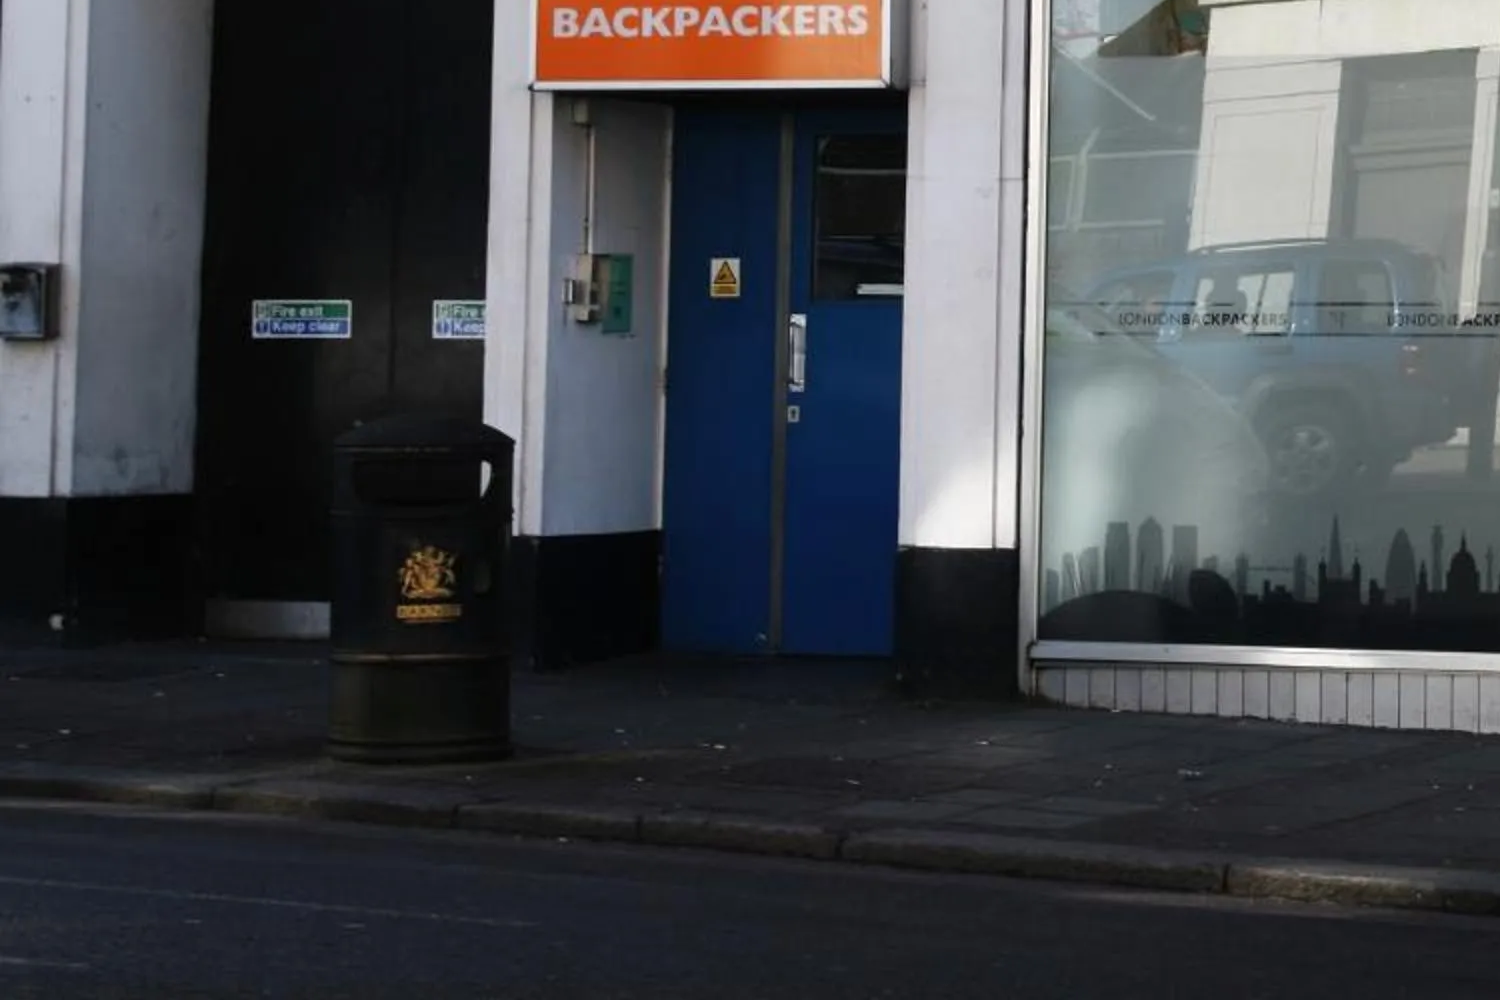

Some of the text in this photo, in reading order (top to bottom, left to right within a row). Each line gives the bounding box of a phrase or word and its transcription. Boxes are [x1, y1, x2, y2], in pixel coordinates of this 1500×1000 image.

[552, 3, 869, 38] BACKPACKERS
[271, 306, 323, 317] Fire exit
[454, 305, 478, 317] Fire
[272, 320, 339, 335] Keep clear
